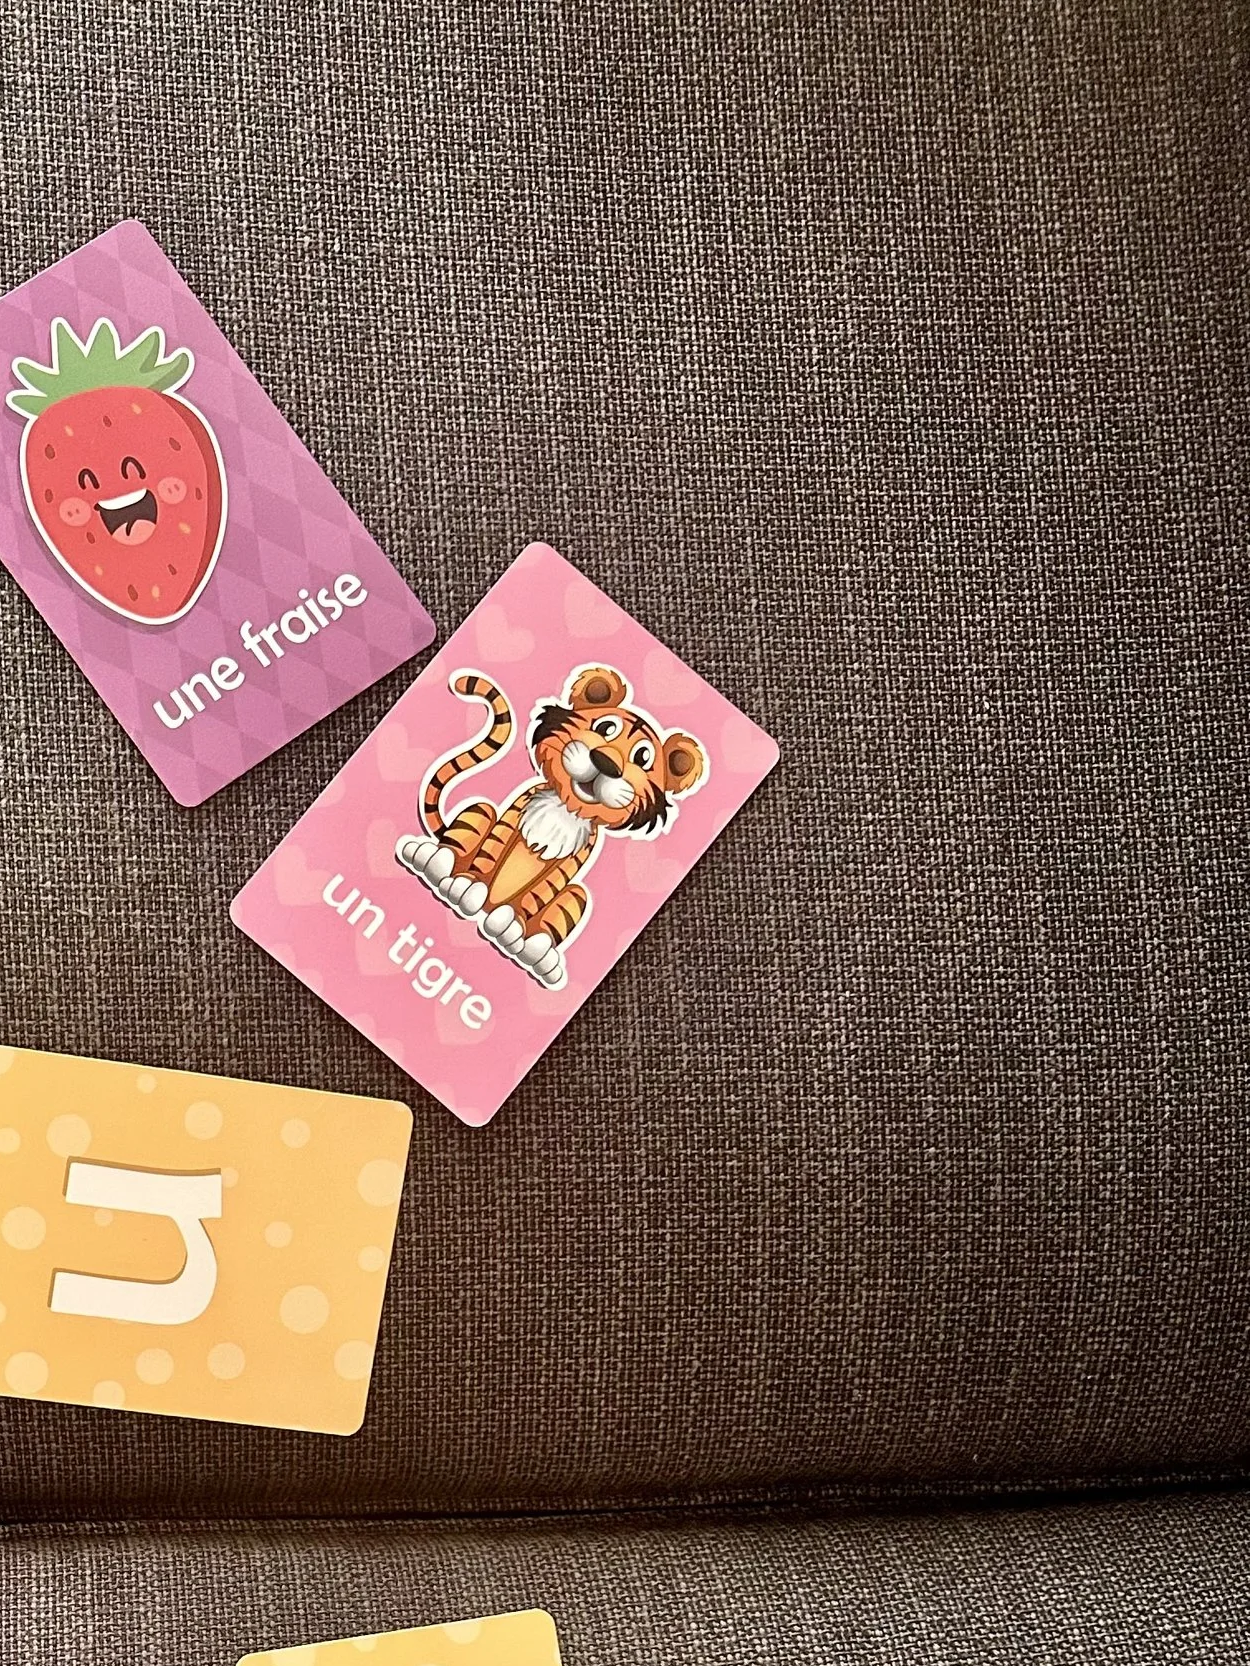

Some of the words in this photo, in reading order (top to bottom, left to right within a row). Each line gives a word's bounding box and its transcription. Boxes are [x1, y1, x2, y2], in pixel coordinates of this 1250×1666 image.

[152, 656, 246, 729] une
[239, 573, 369, 668] fraise
[322, 873, 386, 940] un
[387, 923, 493, 1030] tigre
